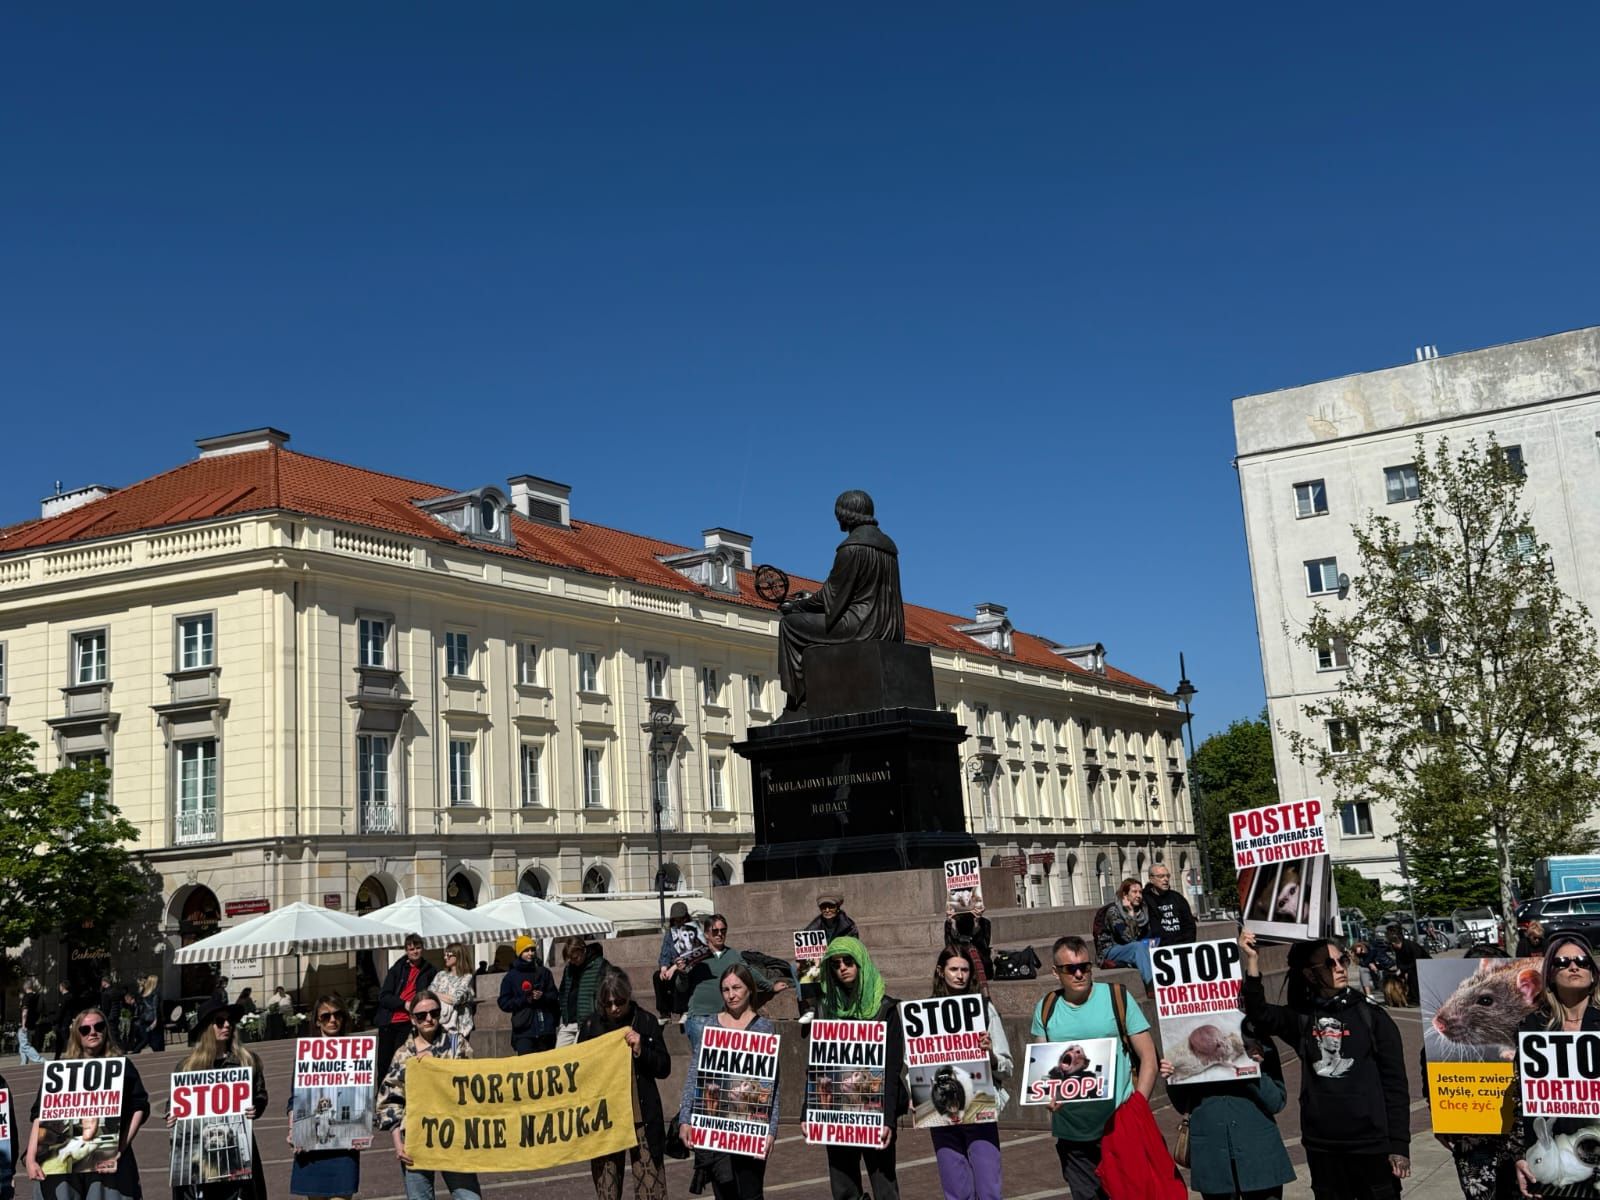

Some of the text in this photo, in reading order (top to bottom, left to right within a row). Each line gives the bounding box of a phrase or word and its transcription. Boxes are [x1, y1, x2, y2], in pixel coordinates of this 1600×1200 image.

[812, 800, 848, 814] RODACY
[1235, 840, 1248, 851] NIE
[1249, 834, 1271, 848] MOŻE
[1272, 827, 1308, 843] OPIERAĆ
[1237, 838, 1326, 867] NA TORTURZE
[946, 860, 977, 877] STOP
[795, 931, 825, 947] STOP
[1152, 941, 1240, 986] STOP
[903, 997, 981, 1037] STOP
[1160, 1006, 1169, 1017] W
[812, 1021, 884, 1042] UWOLNIĆ
[704, 1029, 777, 1055] UWOLNIĆ
[700, 1048, 775, 1078] MAKAKI
[811, 1042, 884, 1066] MAKAKI
[909, 1049, 987, 1065] W LABORATORIACH
[45, 1060, 122, 1094] STOP
[298, 1062, 309, 1073] W
[311, 1061, 346, 1073] NAUCE
[174, 1069, 250, 1086] WIWISEKCJA
[452, 1061, 580, 1105] TORTURY
[1436, 1074, 1476, 1083] Jestem
[1031, 1076, 1104, 1100] STOP!
[1438, 1086, 1474, 1098] Myślę,
[43, 1091, 120, 1108] OKRUTNYM
[173, 1082, 250, 1119] STOP
[1439, 1100, 1496, 1112] Chcę żyć.
[1526, 1101, 1538, 1114] W
[42, 1106, 119, 1119] EKSPERYMENTOM
[808, 1111, 881, 1126] Z UNIWERSYTETU
[422, 1098, 613, 1150] TO NIE NAUKA
[693, 1116, 698, 1127] Z
[699, 1117, 767, 1136] UNIWERSYTETU
[809, 1123, 882, 1145] W PARMIE
[691, 1128, 765, 1155] W PARMIE
